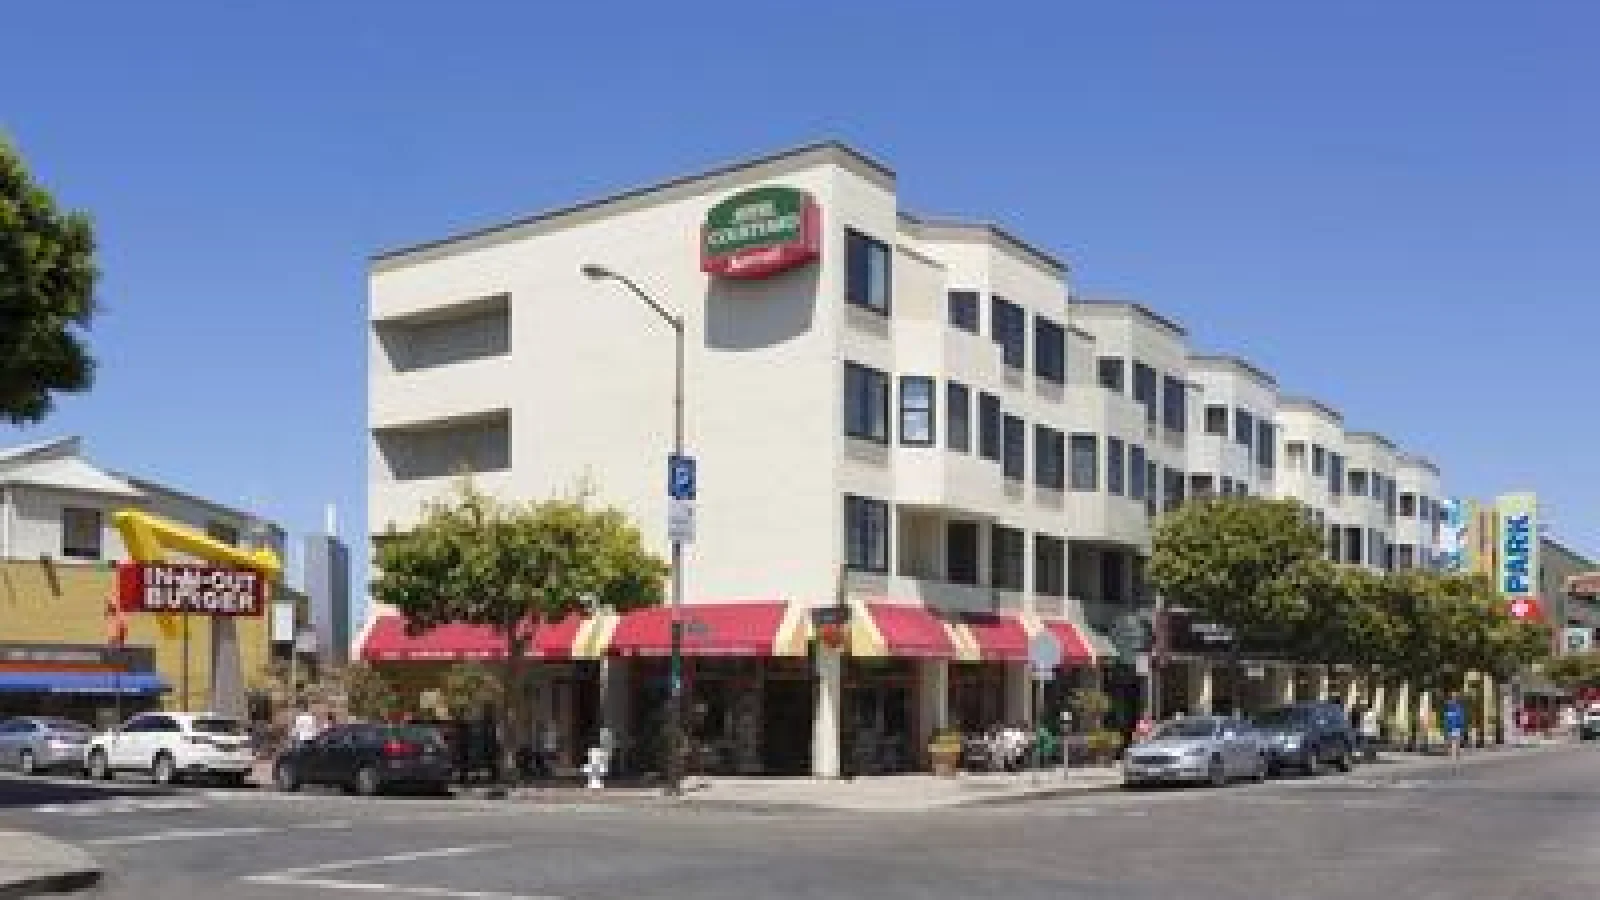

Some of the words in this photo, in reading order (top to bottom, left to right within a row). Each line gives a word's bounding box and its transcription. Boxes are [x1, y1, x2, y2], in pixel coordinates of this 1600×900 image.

[1504, 512, 1529, 593] PARK
[143, 566, 257, 594] IN-N-OUT
[144, 586, 257, 611] BURGER
